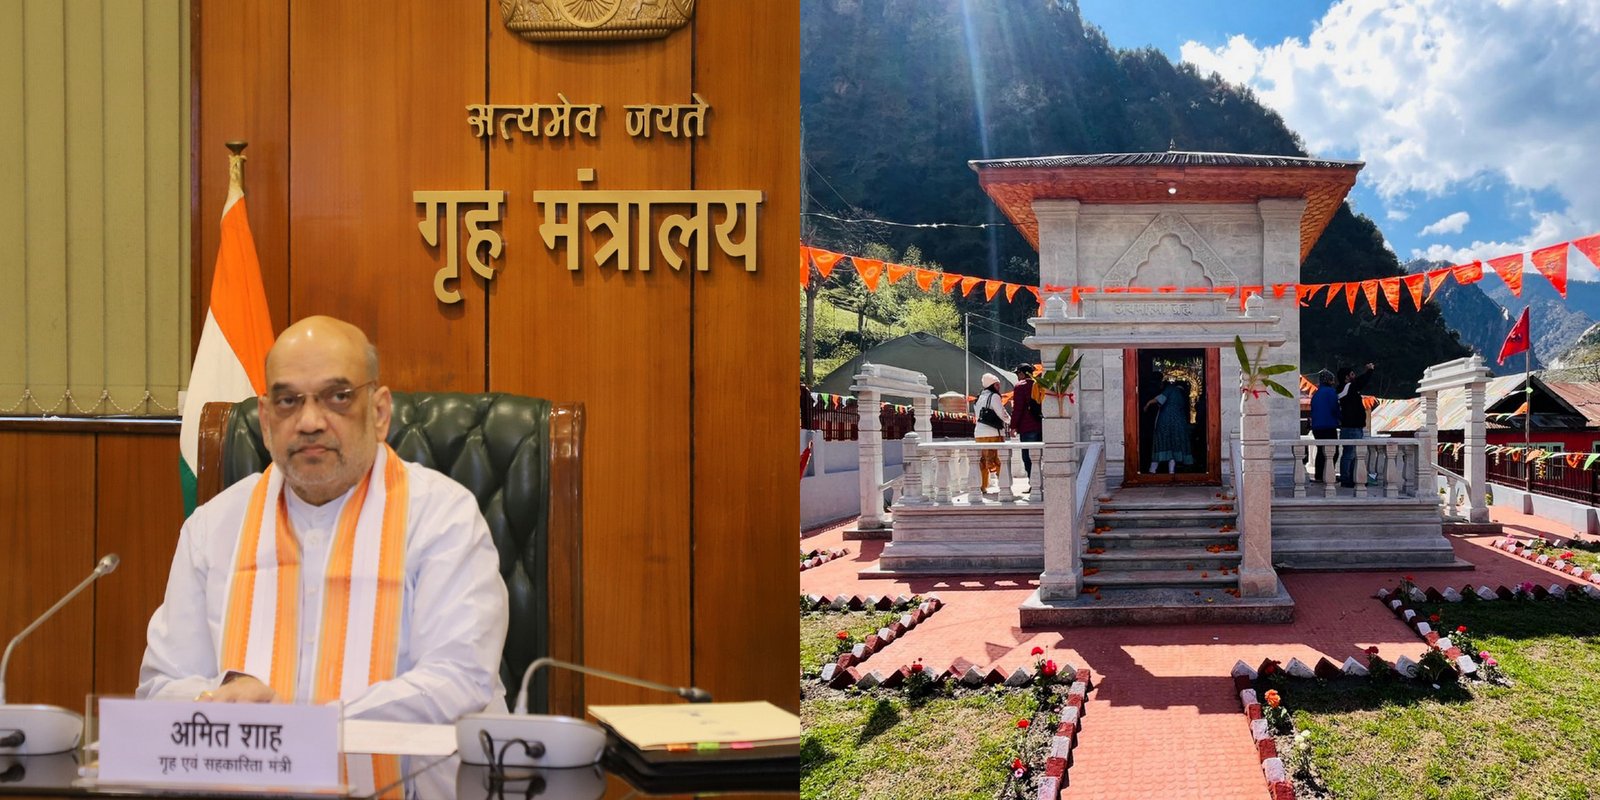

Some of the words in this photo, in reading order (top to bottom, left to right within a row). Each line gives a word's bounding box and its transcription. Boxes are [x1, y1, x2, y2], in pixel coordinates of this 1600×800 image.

[465, 92, 602, 139] सत्यमेव
[623, 93, 709, 137] जयते
[413, 190, 504, 304] गृह
[533, 168, 762, 271] मंत्रालय
[170, 711, 231, 748] अमित
[238, 723, 283, 752] शाह
[158, 756, 177, 775] गृह
[181, 754, 199, 773] एवं
[203, 755, 263, 774] सहकारिता
[268, 755, 292, 774] मंत्री
